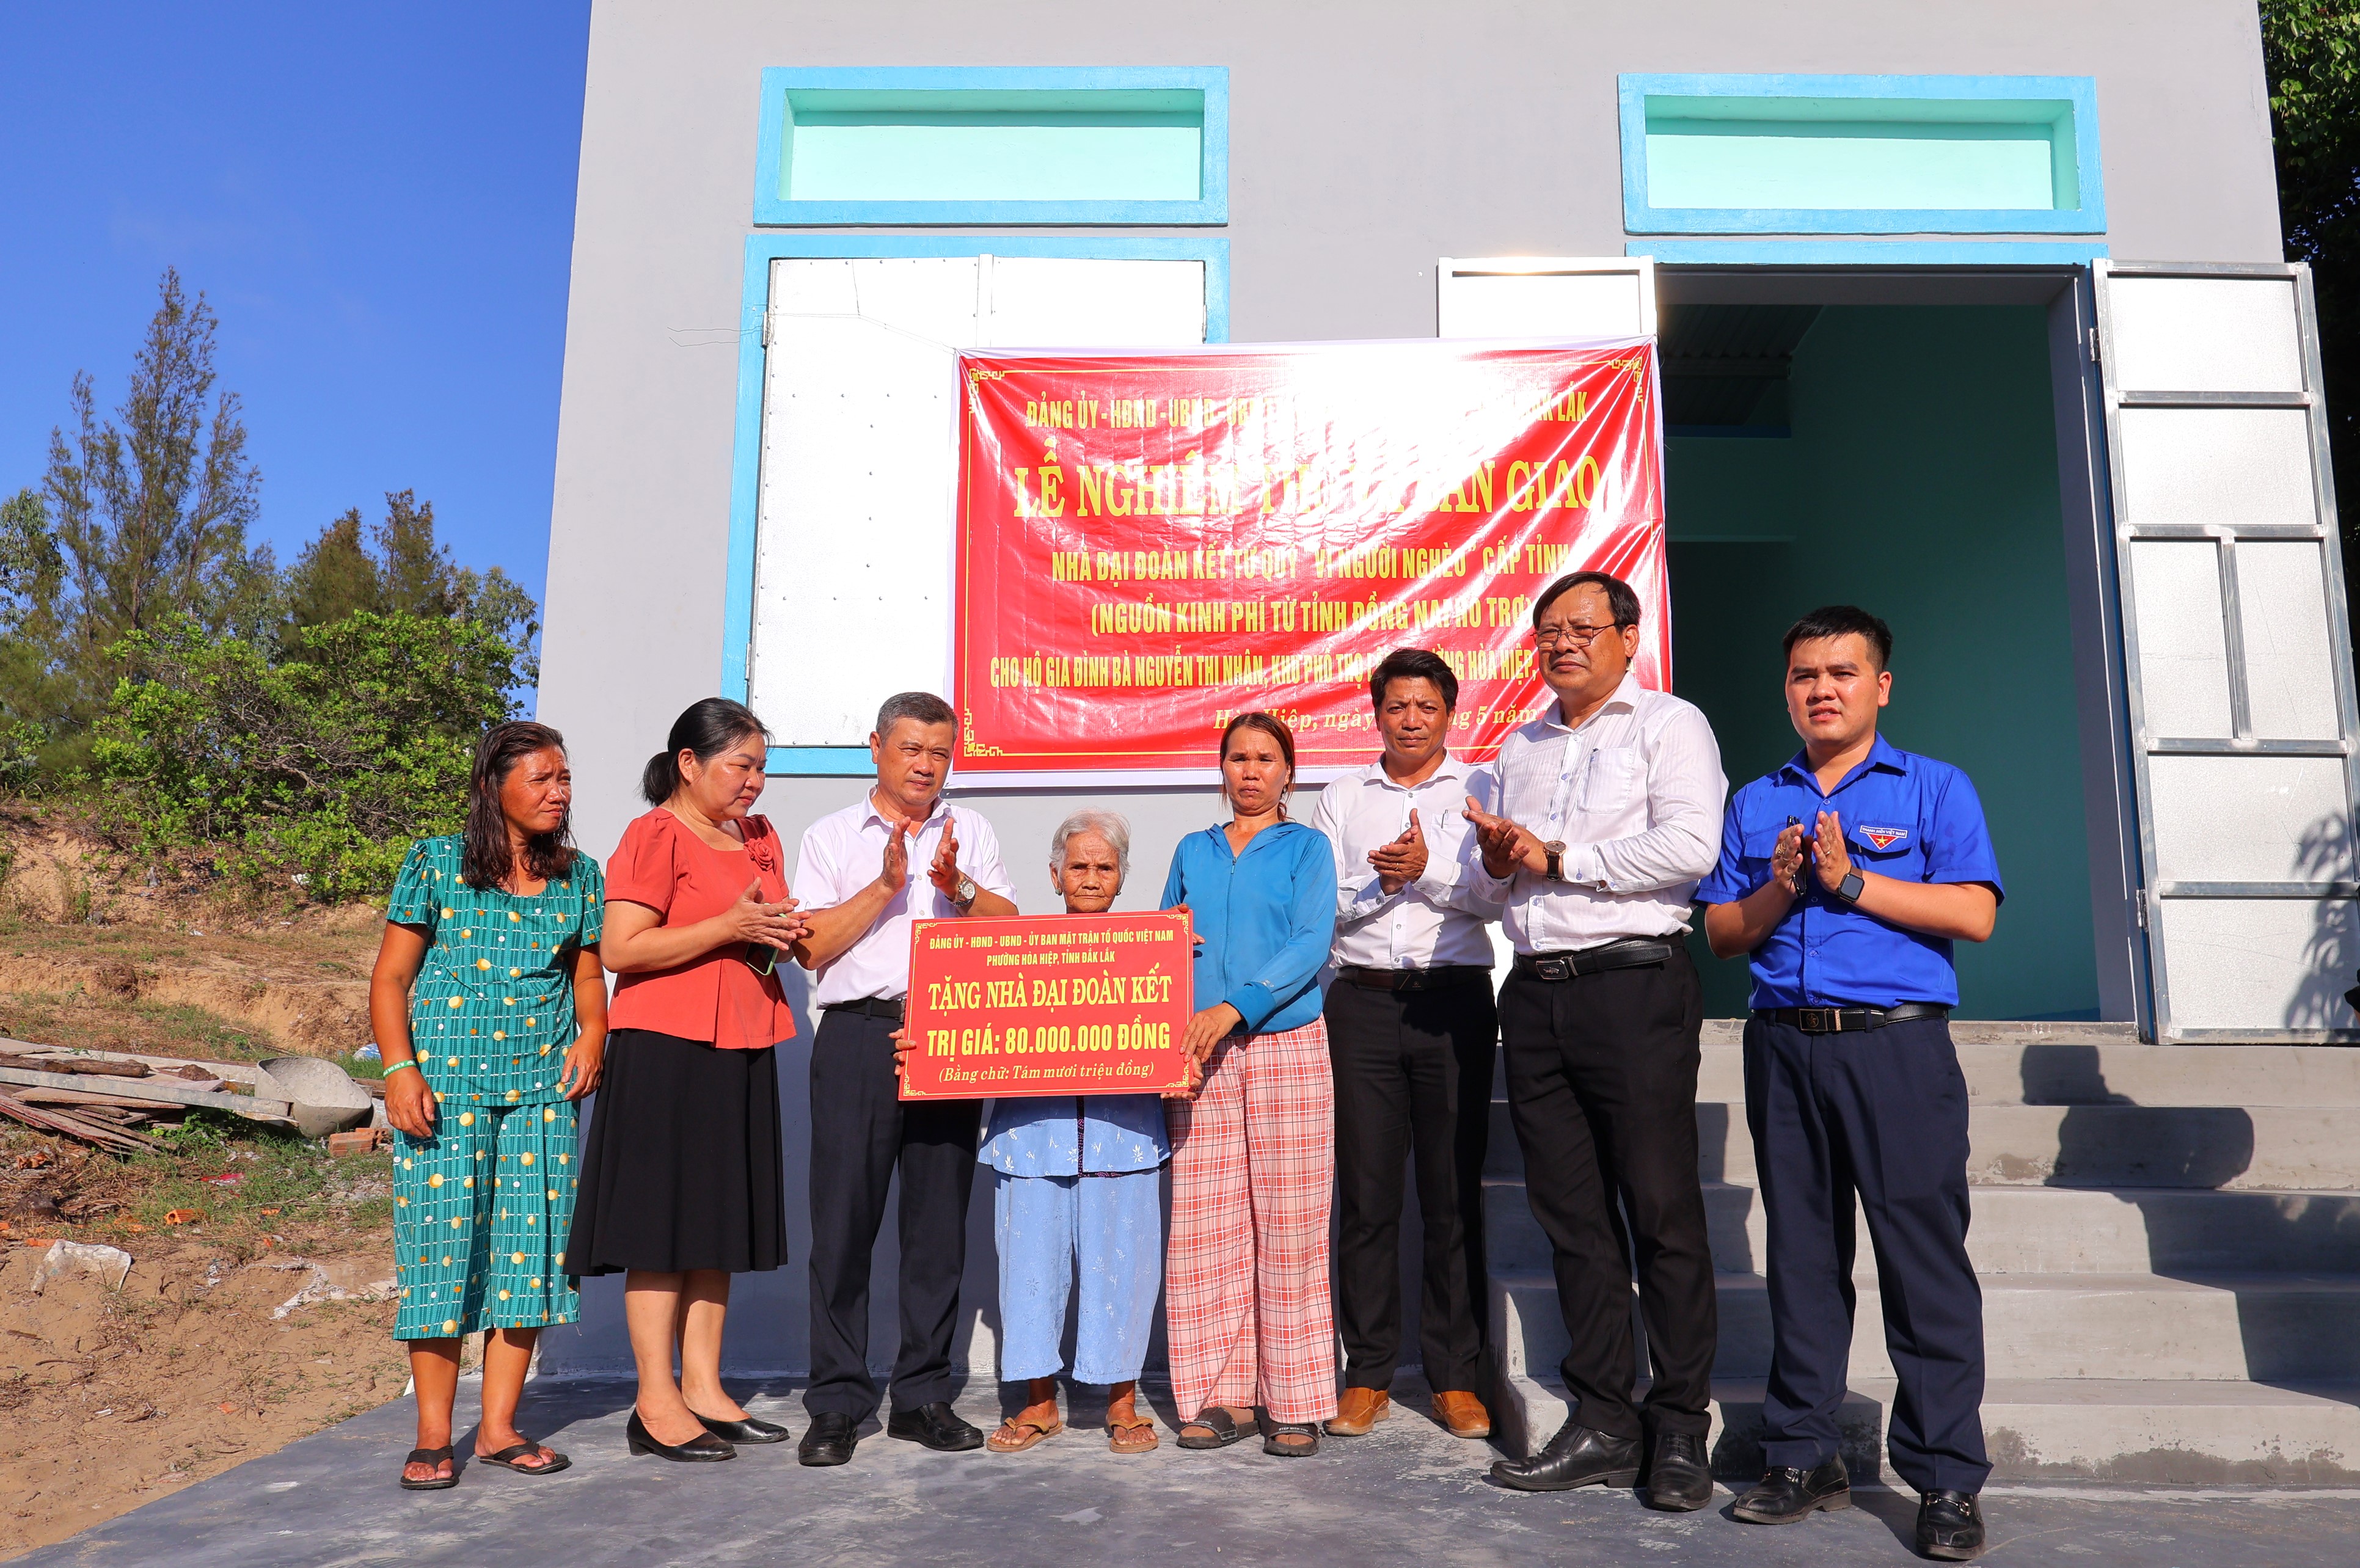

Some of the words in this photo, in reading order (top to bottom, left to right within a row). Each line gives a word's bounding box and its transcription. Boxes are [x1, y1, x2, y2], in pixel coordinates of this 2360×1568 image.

[1026, 391, 1073, 428] ĐẢNG
[1078, 390, 1098, 429] ỦY
[1111, 399, 1156, 428] HĐND
[1014, 438, 1065, 517] LỄ
[1076, 450, 1243, 528] NGHIỆM
[1507, 456, 1600, 512] GIAO
[1052, 545, 1092, 581] NHÀ
[1097, 551, 1128, 587] ĐẠI
[1134, 544, 1187, 580] ĐOÀN
[1193, 540, 1226, 579] KẾT
[1338, 541, 1397, 578] NGƯỜI
[1482, 535, 1521, 574] CẤP
[1525, 534, 1569, 574] TỈNH
[1092, 593, 1171, 637] (NGUỒN
[1177, 602, 1225, 632] KINH
[1231, 595, 1265, 632] PHÍ
[1271, 595, 1297, 632] TỪ
[1300, 591, 1346, 632] TỈNH
[1352, 591, 1408, 632] ĐỒNG
[990, 657, 1019, 687] CHO
[1023, 651, 1042, 694] HỘ
[1046, 657, 1070, 687] GIA
[1073, 650, 1108, 687] ĐÌNH
[1112, 650, 1131, 687] BÀ
[1135, 644, 1193, 687] NGUYỄN
[1196, 655, 1219, 692] THỊ
[1222, 649, 1268, 691] NHẬN,
[1271, 655, 1300, 684] KHU
[1336, 653, 1363, 689] THỌ
[1468, 643, 1497, 680] HÒA
[1500, 643, 1536, 685] HIỆP,
[1323, 709, 1375, 731] ngày
[1476, 706, 1488, 725] 5
[1492, 704, 1538, 723] năm
[930, 935, 951, 949] ĐẢNG
[954, 934, 964, 948] ỦY
[971, 936, 993, 948] HĐND
[999, 935, 1021, 947] UBND
[1029, 931, 1039, 946] ỦY
[1041, 933, 1057, 945] BAN
[1059, 932, 1076, 947] MẶT
[1078, 930, 1099, 946] TRẬN
[1101, 927, 1111, 943] TỔ
[1112, 927, 1134, 944] QUỐC
[1136, 928, 1153, 944] VIỆT
[1155, 930, 1174, 942] NAM
[987, 952, 1020, 966] PHƯỜNG
[1021, 951, 1037, 965] HÒA
[1040, 951, 1059, 967] HIỆP,
[1062, 949, 1080, 964] TỈNH
[1082, 947, 1098, 963] ĐẮK
[1100, 947, 1115, 963] LẮK
[928, 975, 981, 1016] TẶNG
[985, 972, 1027, 1008] NHÀ
[1032, 979, 1067, 1013] ĐẠI
[1072, 969, 1126, 1005] ĐOÀN
[1131, 962, 1172, 1003] KẾT
[927, 1029, 956, 1062] TRỊ
[961, 1023, 999, 1056] GIÁ:
[1005, 1024, 1112, 1054] 80.000.000
[1117, 1014, 1170, 1050] ĐỒNG
[939, 1064, 978, 1084] (Bằng
[981, 1067, 1009, 1081] chữ:
[1013, 1065, 1040, 1079] Tám
[1042, 1064, 1077, 1078] mươi
[1080, 1063, 1112, 1080] triệu
[1116, 1059, 1154, 1078] đồng)
